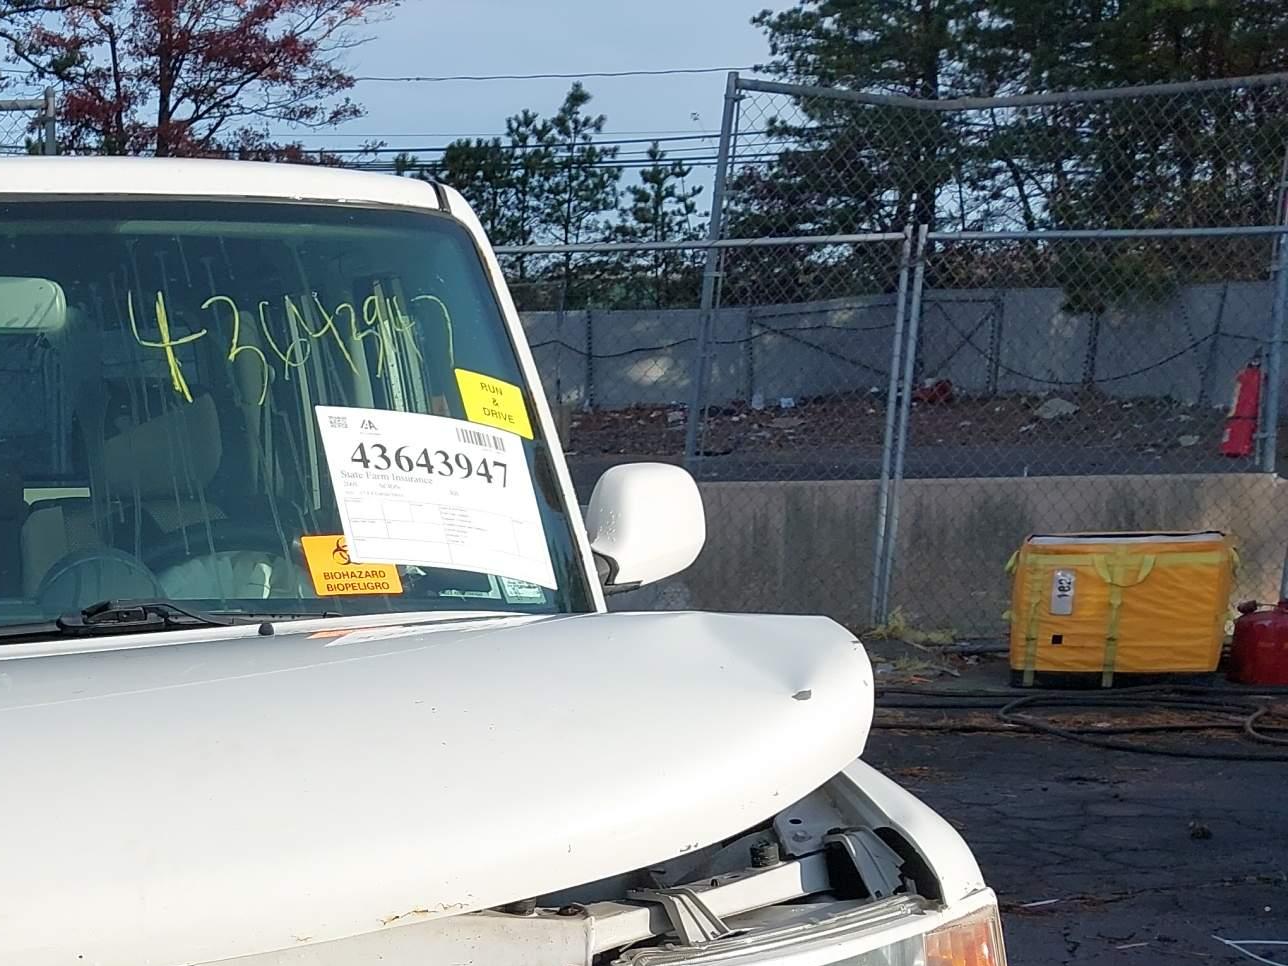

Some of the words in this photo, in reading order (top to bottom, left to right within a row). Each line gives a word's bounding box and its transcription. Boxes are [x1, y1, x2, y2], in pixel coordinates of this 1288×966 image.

[479, 382, 503, 396] RUN
[492, 397, 499, 406] &
[482, 407, 516, 424] DRIVE
[351, 442, 508, 488] 43643947
[340, 470, 364, 480] State
[365, 471, 390, 481] Farm
[391, 472, 433, 484] Insurance
[323, 570, 386, 580] BIOHAZARD
[326, 582, 390, 592] BIOPELIGRO
